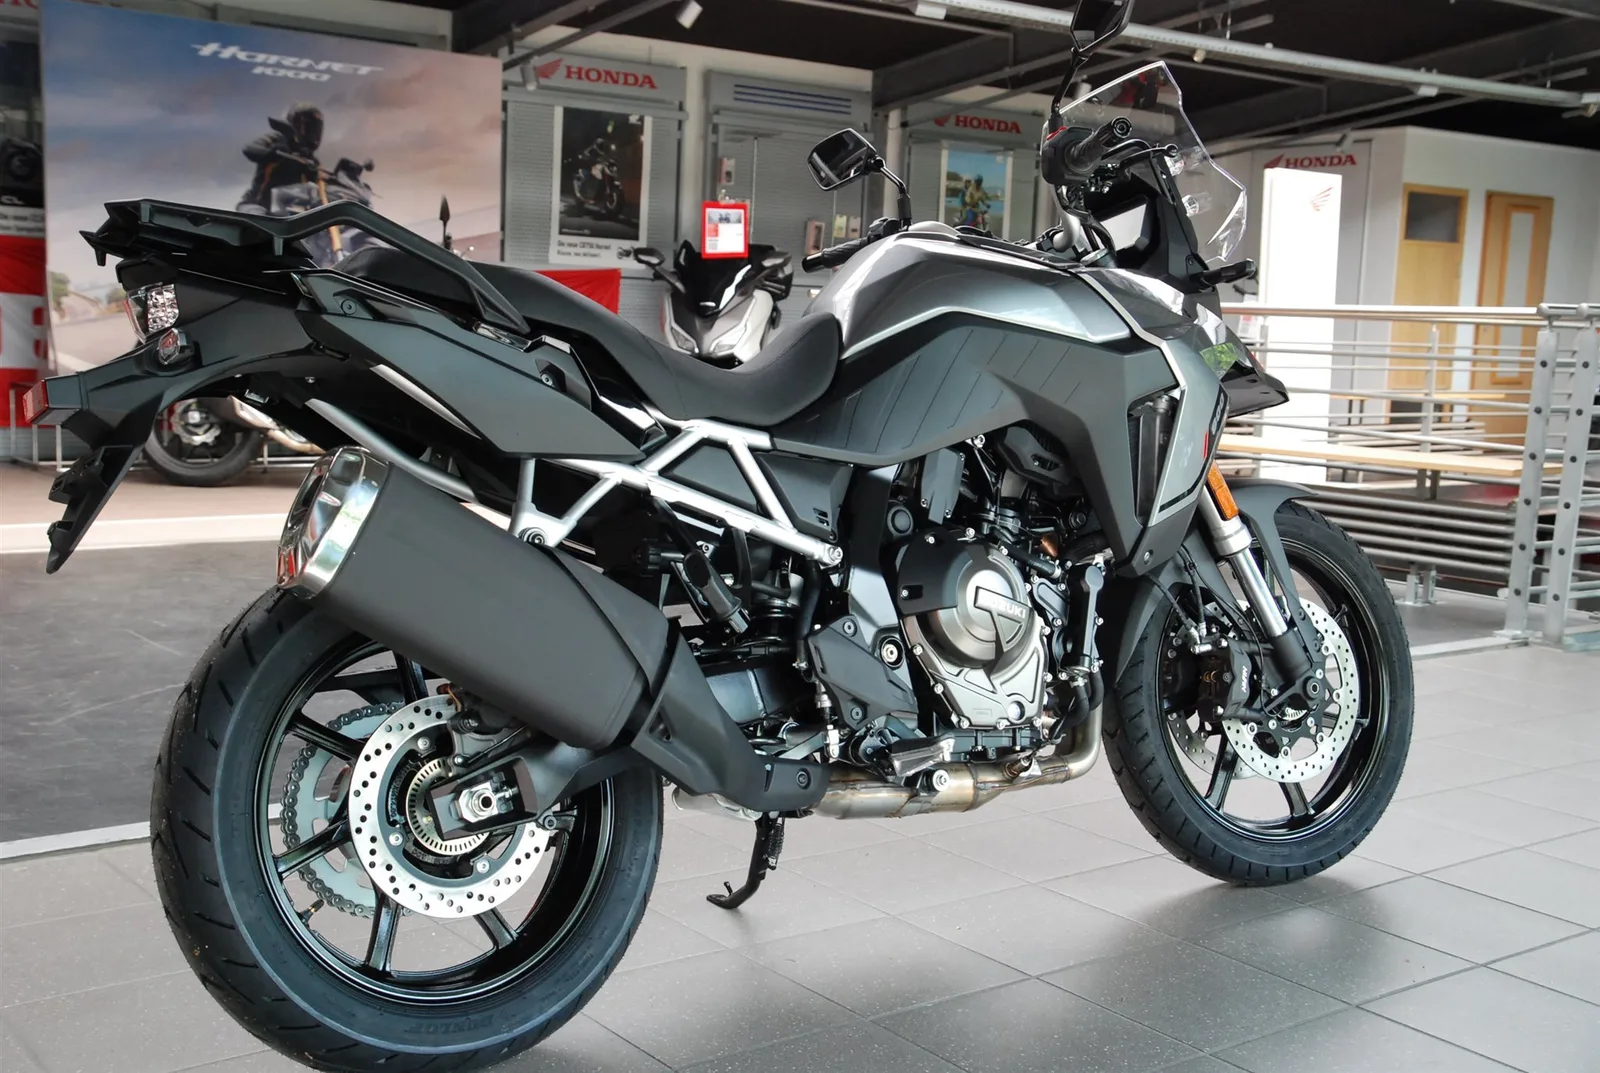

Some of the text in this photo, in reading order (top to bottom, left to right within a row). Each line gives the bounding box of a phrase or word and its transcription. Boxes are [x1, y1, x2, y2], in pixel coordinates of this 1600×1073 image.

[190, 42, 384, 75] HORNET
[252, 65, 331, 82] 1000
[564, 64, 658, 89] HONDA
[954, 114, 1022, 135] HONDA
[1284, 153, 1357, 169] HONDA
[984, 596, 1026, 619] UZUKI
[408, 1014, 495, 1035] DUNLOP
